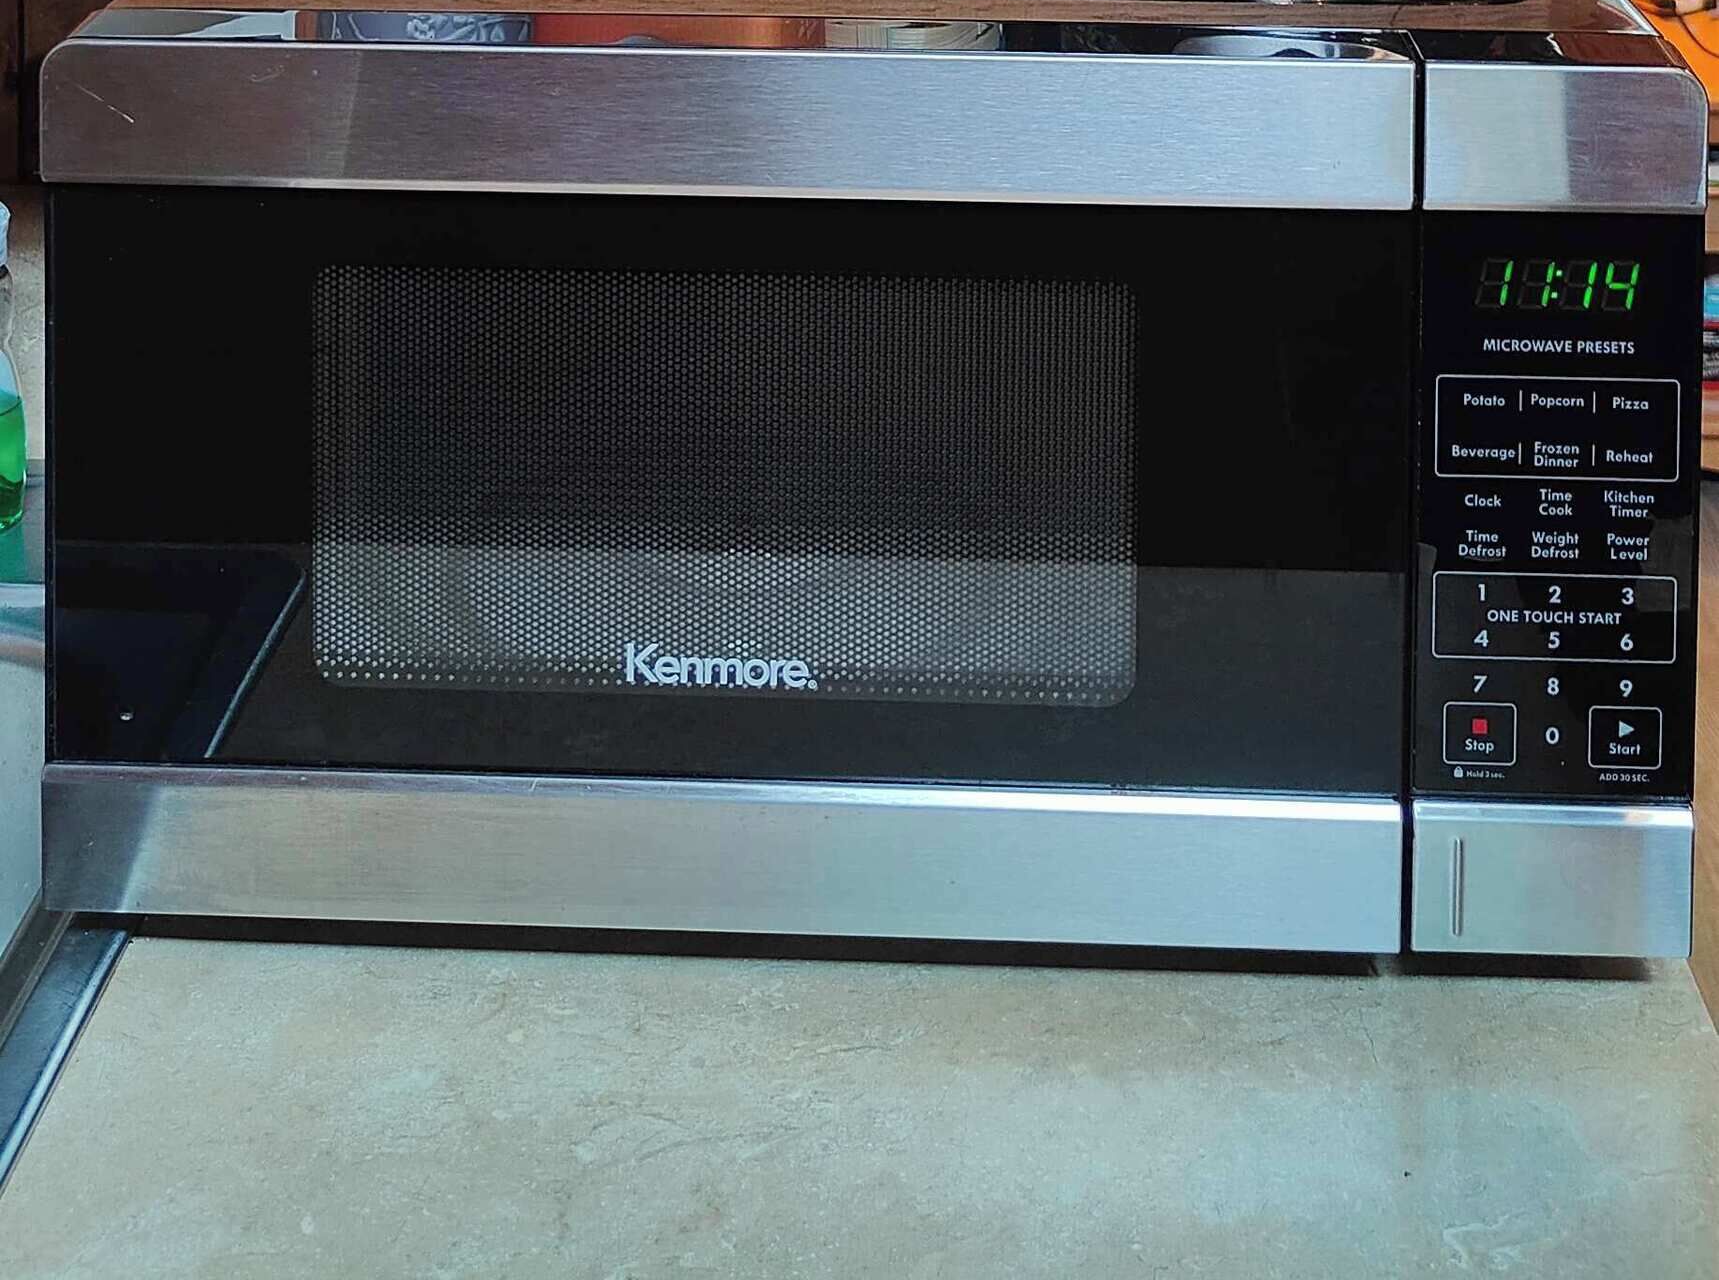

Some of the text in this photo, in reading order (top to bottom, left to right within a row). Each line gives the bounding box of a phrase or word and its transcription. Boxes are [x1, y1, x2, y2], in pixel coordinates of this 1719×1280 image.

[1499, 260, 1641, 310] 11:14
[1483, 339, 1636, 355] MICROWAVE PRESETS
[1463, 393, 1506, 407] Potato
[1530, 393, 1585, 410] Popcorn
[1612, 397, 1649, 410] Pizza
[1451, 444, 1516, 461] Beverage
[1534, 441, 1580, 454] Frozen
[1534, 455, 1580, 468] Dinner
[1606, 450, 1653, 464] Reheat
[1464, 494, 1502, 507] Clock
[1539, 488, 1573, 501] Time
[1604, 490, 1655, 504] Kitchen
[1538, 502, 1573, 516] Cook
[1609, 505, 1649, 518] Timer
[1466, 530, 1499, 543] Time
[1532, 531, 1579, 546] Weight
[1607, 533, 1650, 546] Power
[1458, 544, 1507, 558] Defrost
[1531, 545, 1580, 559] Defrost
[1610, 547, 1649, 561] Level
[1478, 584, 1487, 601] 1
[1548, 586, 1562, 604] 2
[1621, 587, 1635, 605] 3
[1487, 610, 1622, 625] ONE TOUCH START
[1474, 630, 1489, 647] 4
[1548, 632, 1560, 649] 5
[1620, 634, 1634, 651] 6
[1473, 675, 1488, 692] 7
[1547, 677, 1560, 695] 8
[1619, 679, 1633, 697] 9
[1545, 727, 1559, 744] 0
[1465, 738, 1494, 754] Stop
[1609, 743, 1641, 755] Start
[1599, 773, 1650, 782] ADD 30 SEC.
